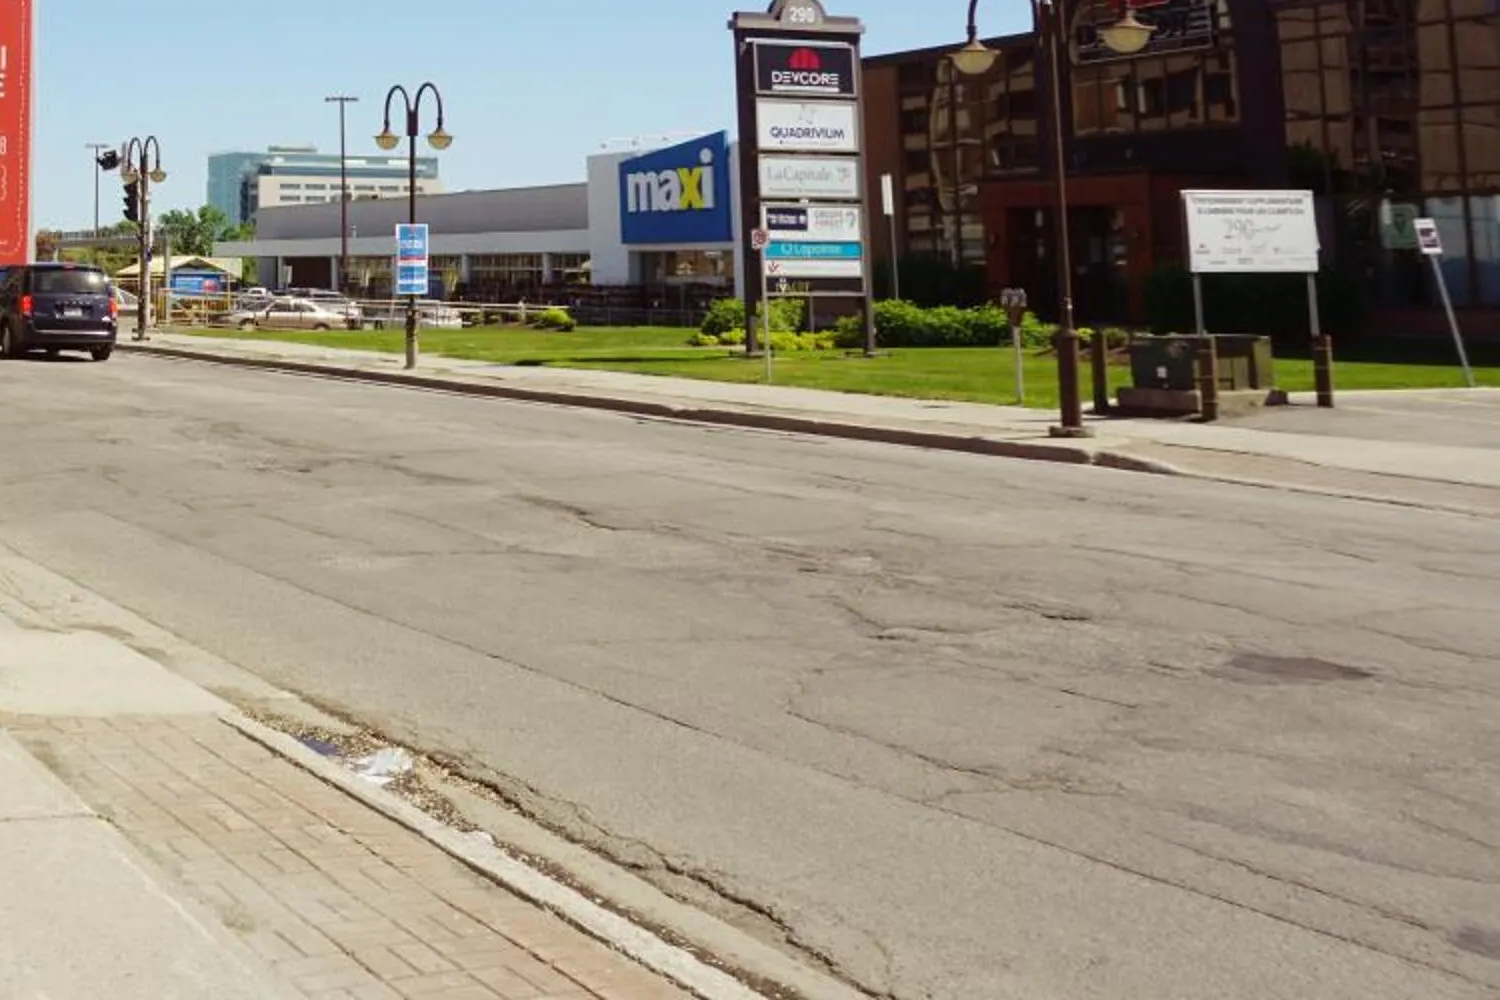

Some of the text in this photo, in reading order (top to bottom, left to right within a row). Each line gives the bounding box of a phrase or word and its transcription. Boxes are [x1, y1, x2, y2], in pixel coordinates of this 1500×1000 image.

[788, 7, 815, 23] 290
[771, 71, 840, 85] DEVCORE
[770, 126, 845, 139] QUADRIVIUM
[627, 147, 715, 213] maxi
